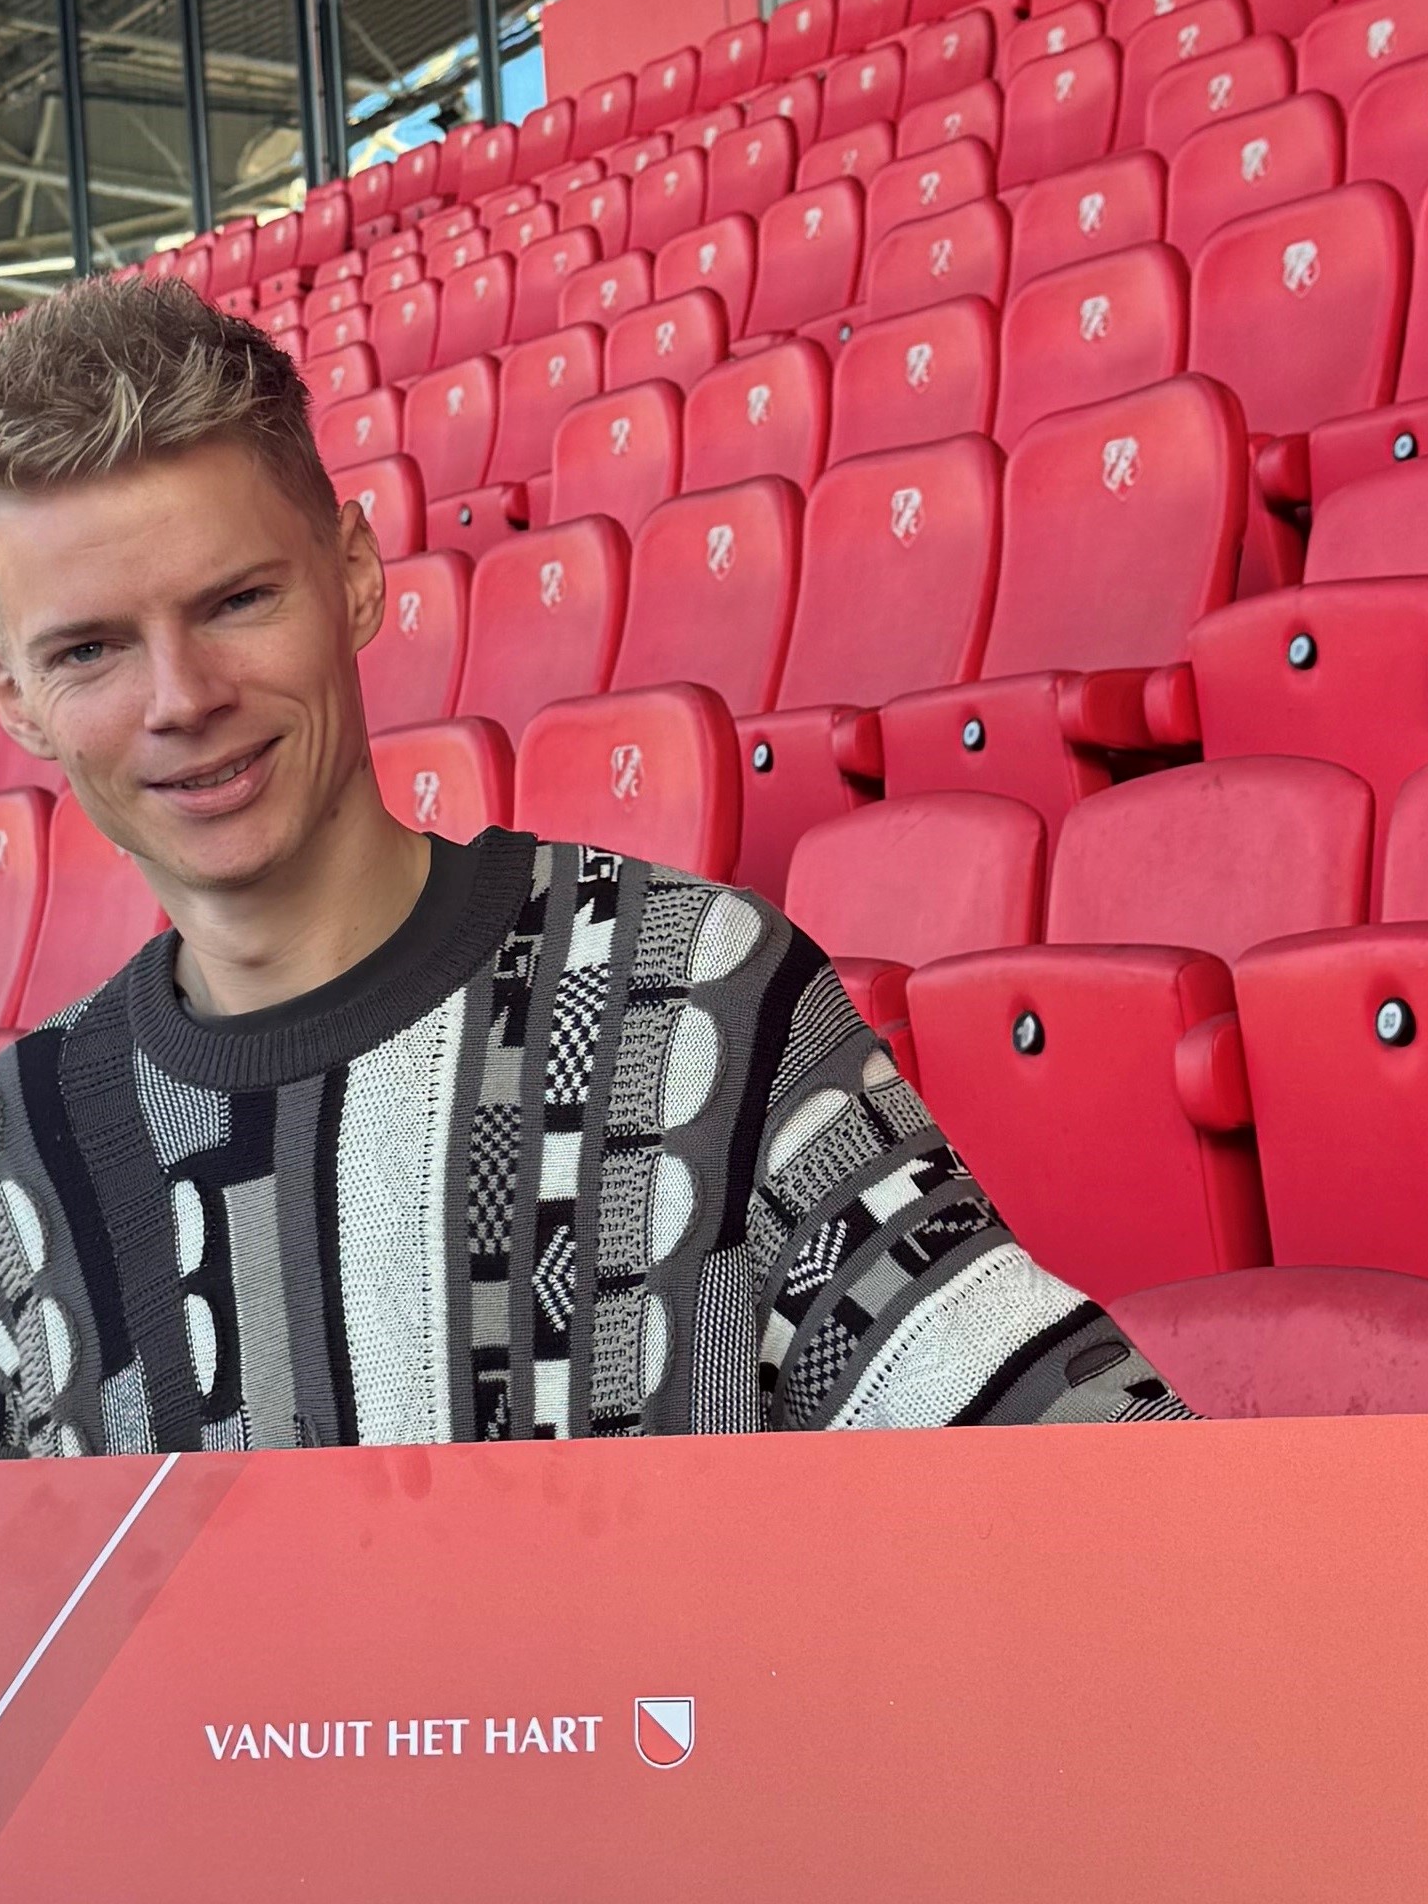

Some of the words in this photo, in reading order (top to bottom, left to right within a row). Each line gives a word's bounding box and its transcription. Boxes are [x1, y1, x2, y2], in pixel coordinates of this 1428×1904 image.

[204, 1720, 373, 1761] VANUIT
[387, 1718, 470, 1756] HET
[484, 1716, 603, 1754] HART
